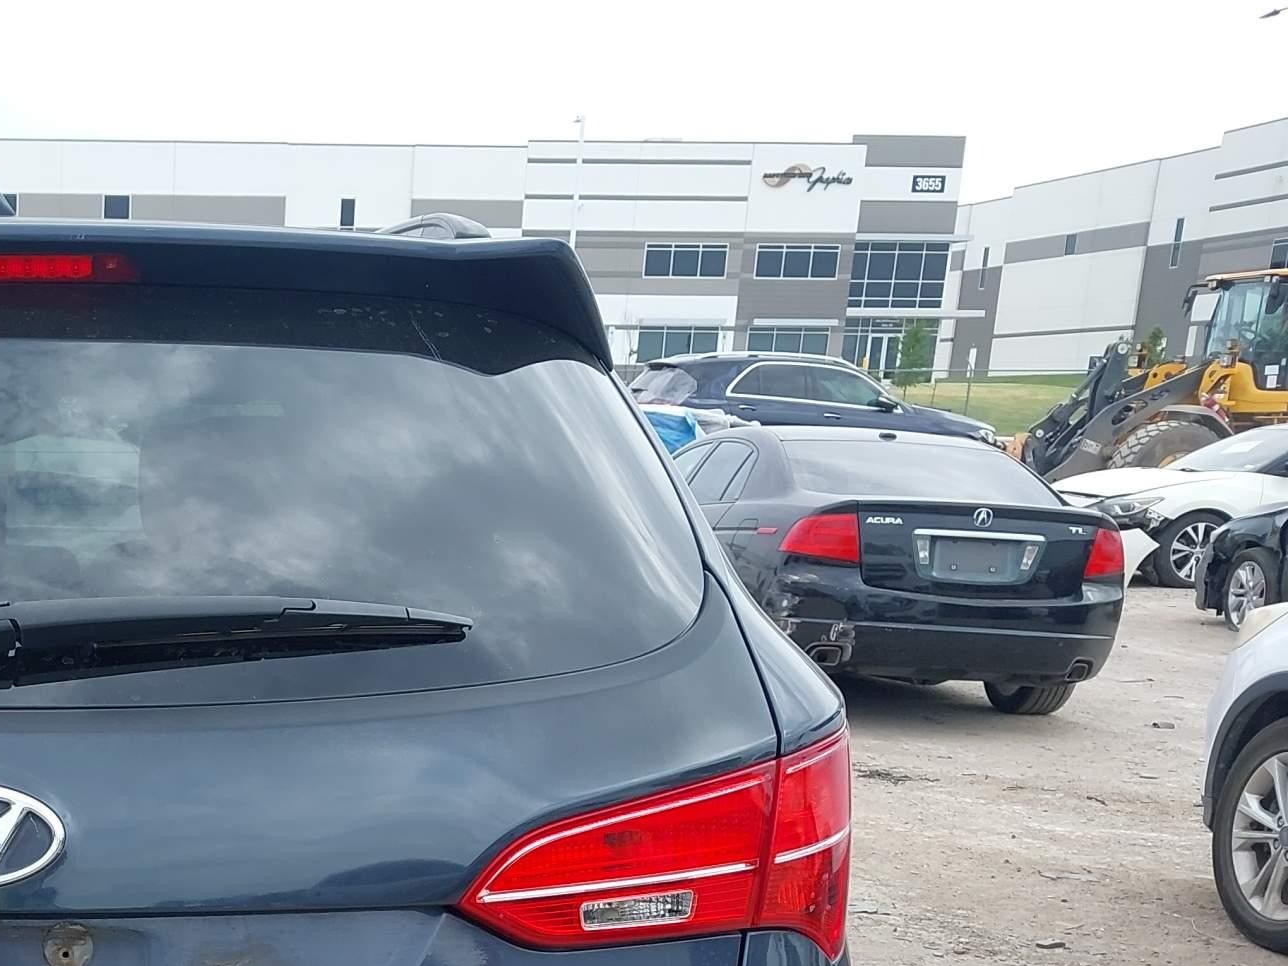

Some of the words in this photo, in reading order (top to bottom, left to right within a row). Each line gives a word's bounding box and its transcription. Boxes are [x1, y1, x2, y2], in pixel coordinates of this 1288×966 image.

[915, 177, 943, 191] 3655
[865, 516, 904, 525] ACURA
[1068, 526, 1088, 535] TL
